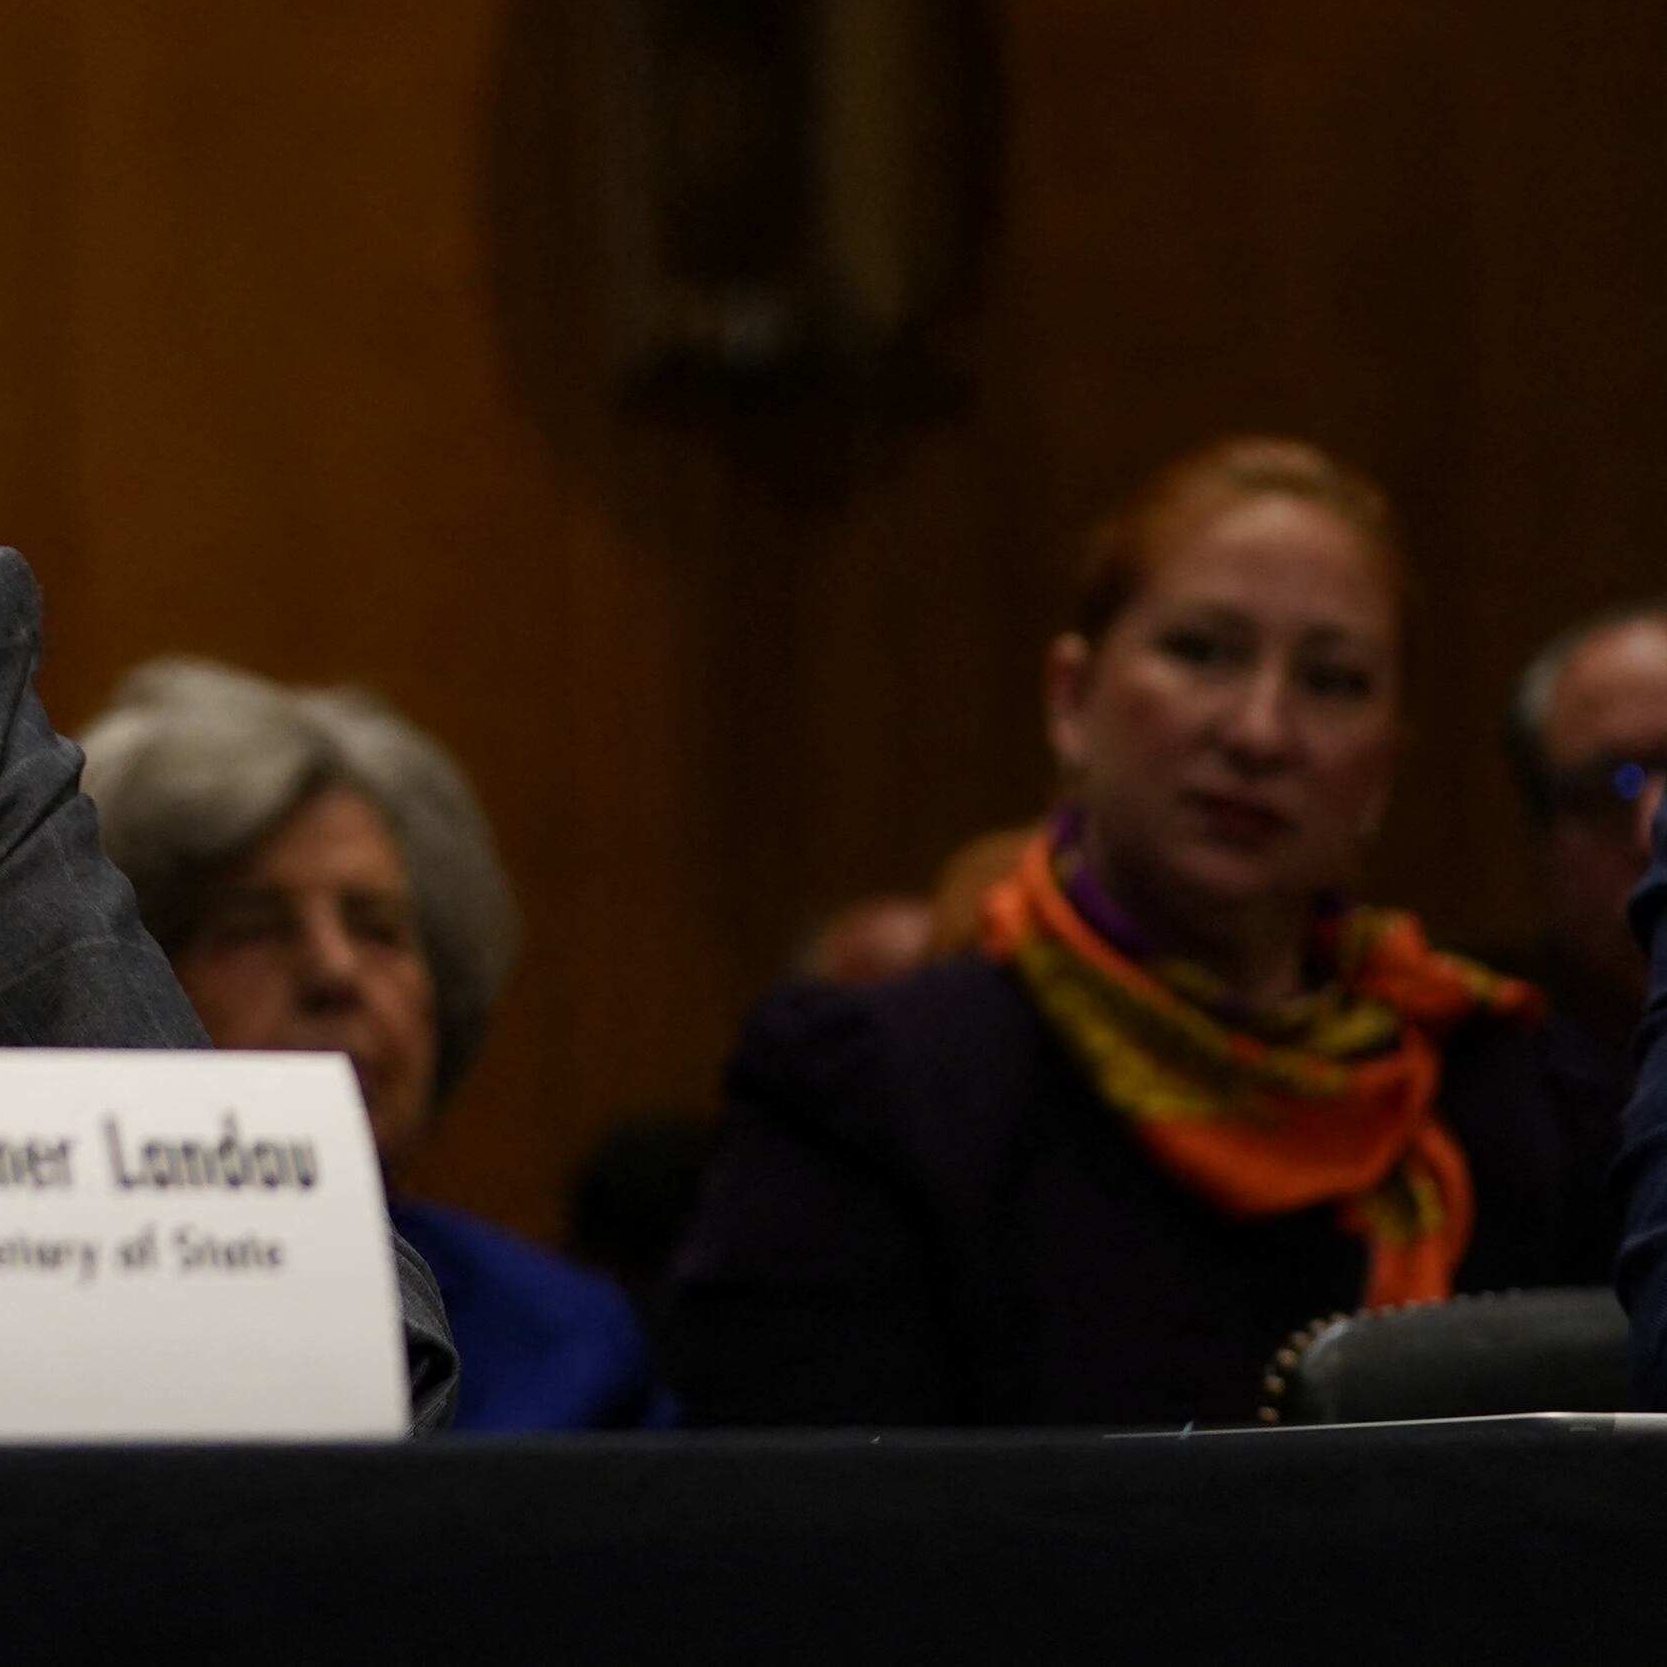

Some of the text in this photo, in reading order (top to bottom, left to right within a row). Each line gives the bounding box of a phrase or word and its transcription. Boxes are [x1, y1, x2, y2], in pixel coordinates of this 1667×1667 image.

[102, 1111, 320, 1190] Landau
[114, 1224, 158, 1270] of
[174, 1227, 287, 1272] State
